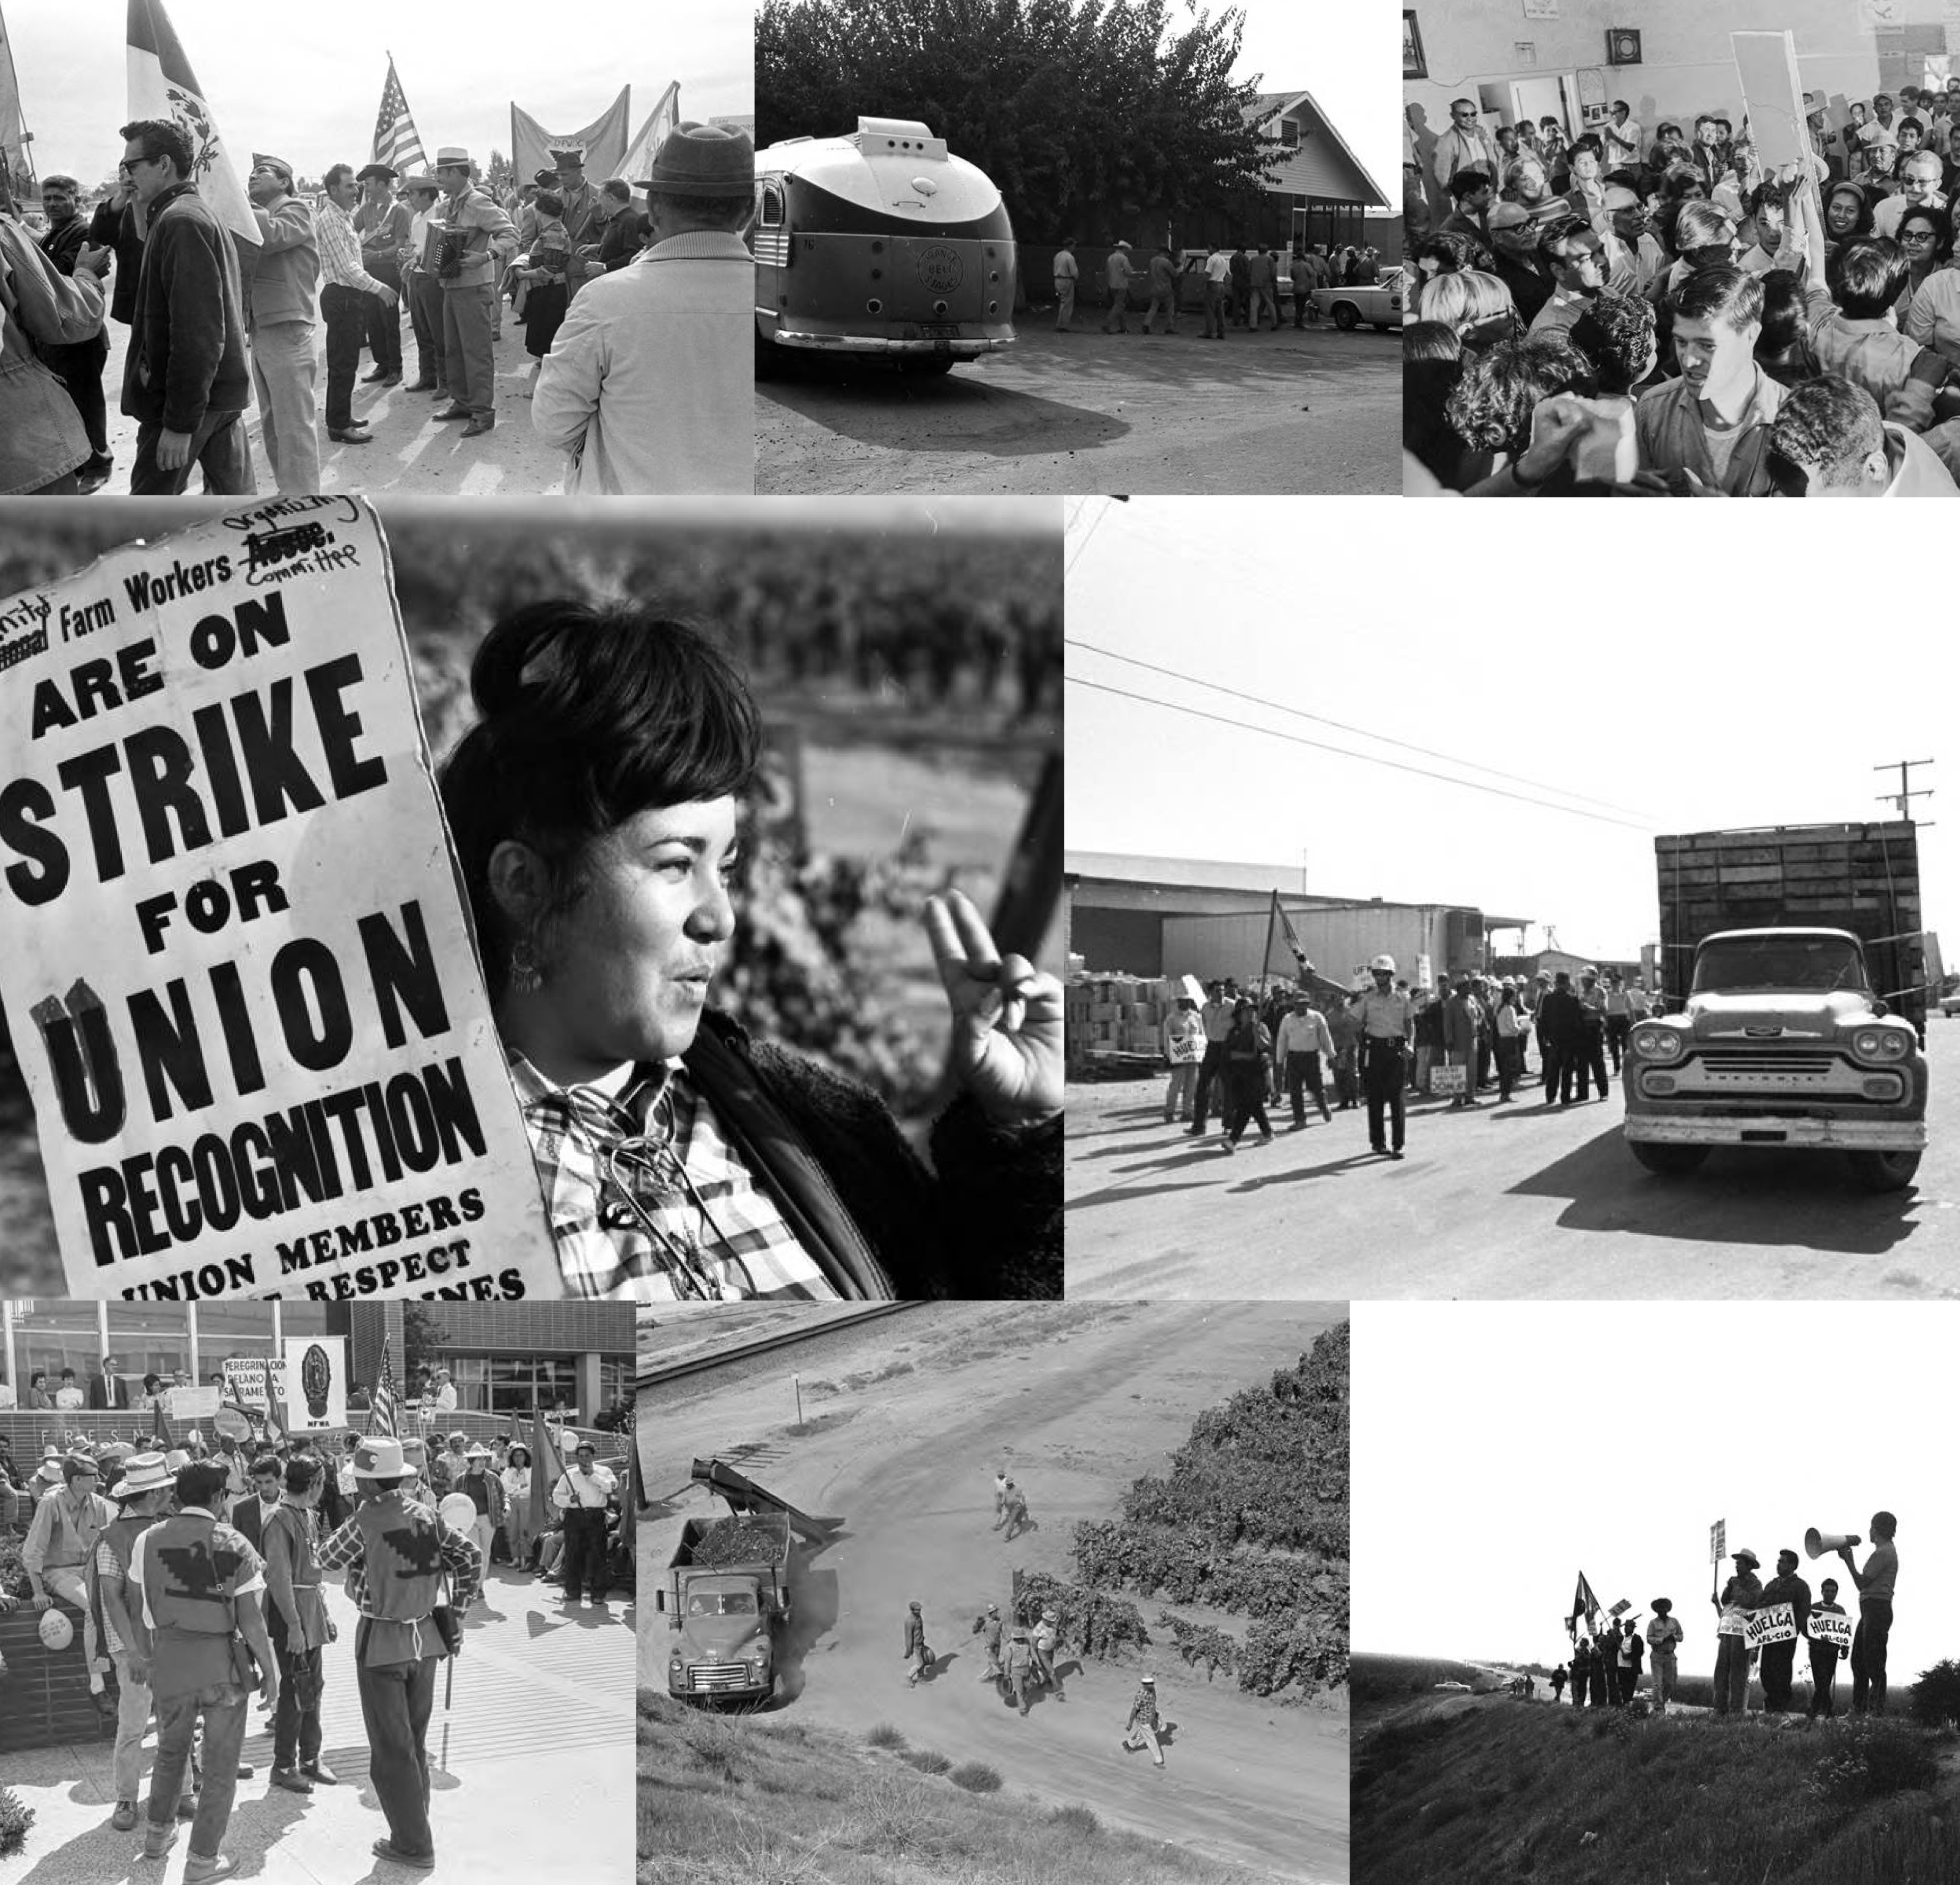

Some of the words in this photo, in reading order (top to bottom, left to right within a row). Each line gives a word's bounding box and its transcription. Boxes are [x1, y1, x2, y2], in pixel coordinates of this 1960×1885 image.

[929, 265, 952, 274] BELT
[60, 598, 117, 643] Farm
[124, 554, 233, 614] Workers
[32, 638, 165, 740] ARE
[190, 591, 291, 670] ON
[0, 653, 388, 907] STRIKE
[135, 859, 290, 955] FOR
[31, 900, 451, 1144] UNION
[77, 1055, 488, 1267] RECOGNITION
[275, 1188, 485, 1275] MEMBERS
[306, 1238, 471, 1300] RESPECT
[400, 1268, 525, 1300] NES
[224, 1361, 286, 1372] PEREGRINCION
[224, 1386, 285, 1397] SARAMETO
[41, 1429, 143, 1445] FRESN
[1746, 1612, 1794, 1640] HUELGA
[1758, 1630, 1792, 1643] AFL-CIO
[1809, 1619, 1851, 1637] HUELGA
